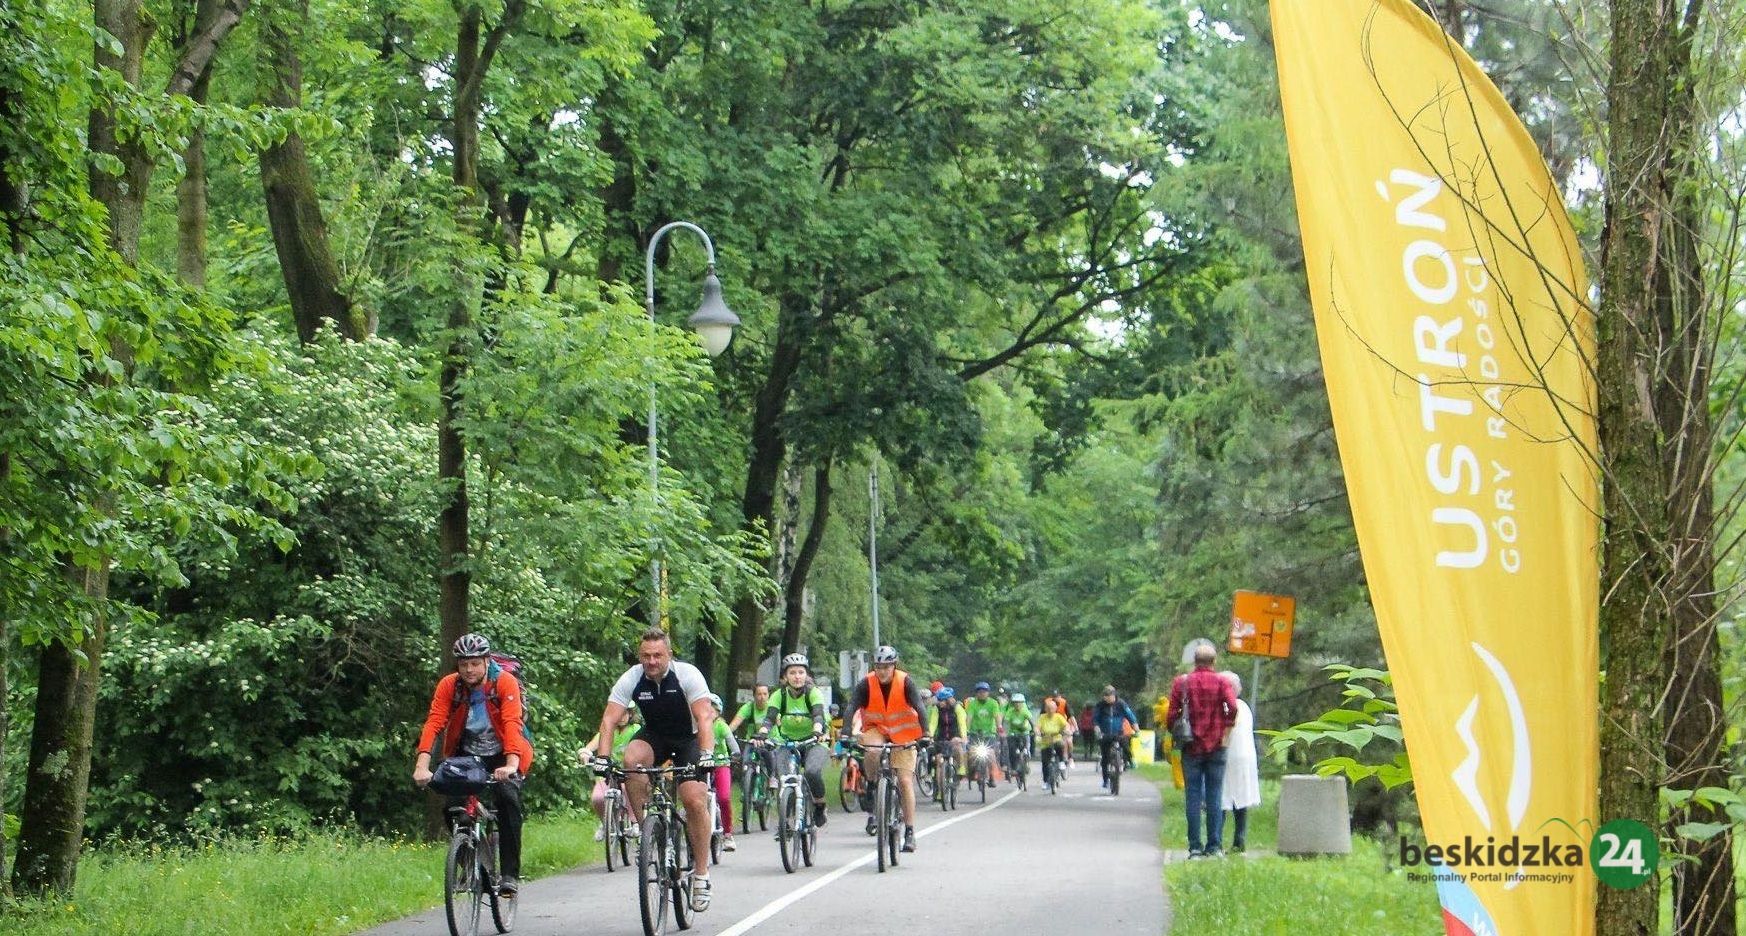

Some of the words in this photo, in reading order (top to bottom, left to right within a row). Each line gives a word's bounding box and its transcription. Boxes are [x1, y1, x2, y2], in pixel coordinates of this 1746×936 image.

[1375, 167, 1489, 569] USTROŃ
[1462, 256, 1508, 439] RADOŚCI
[1493, 459, 1521, 574] GÓRY
